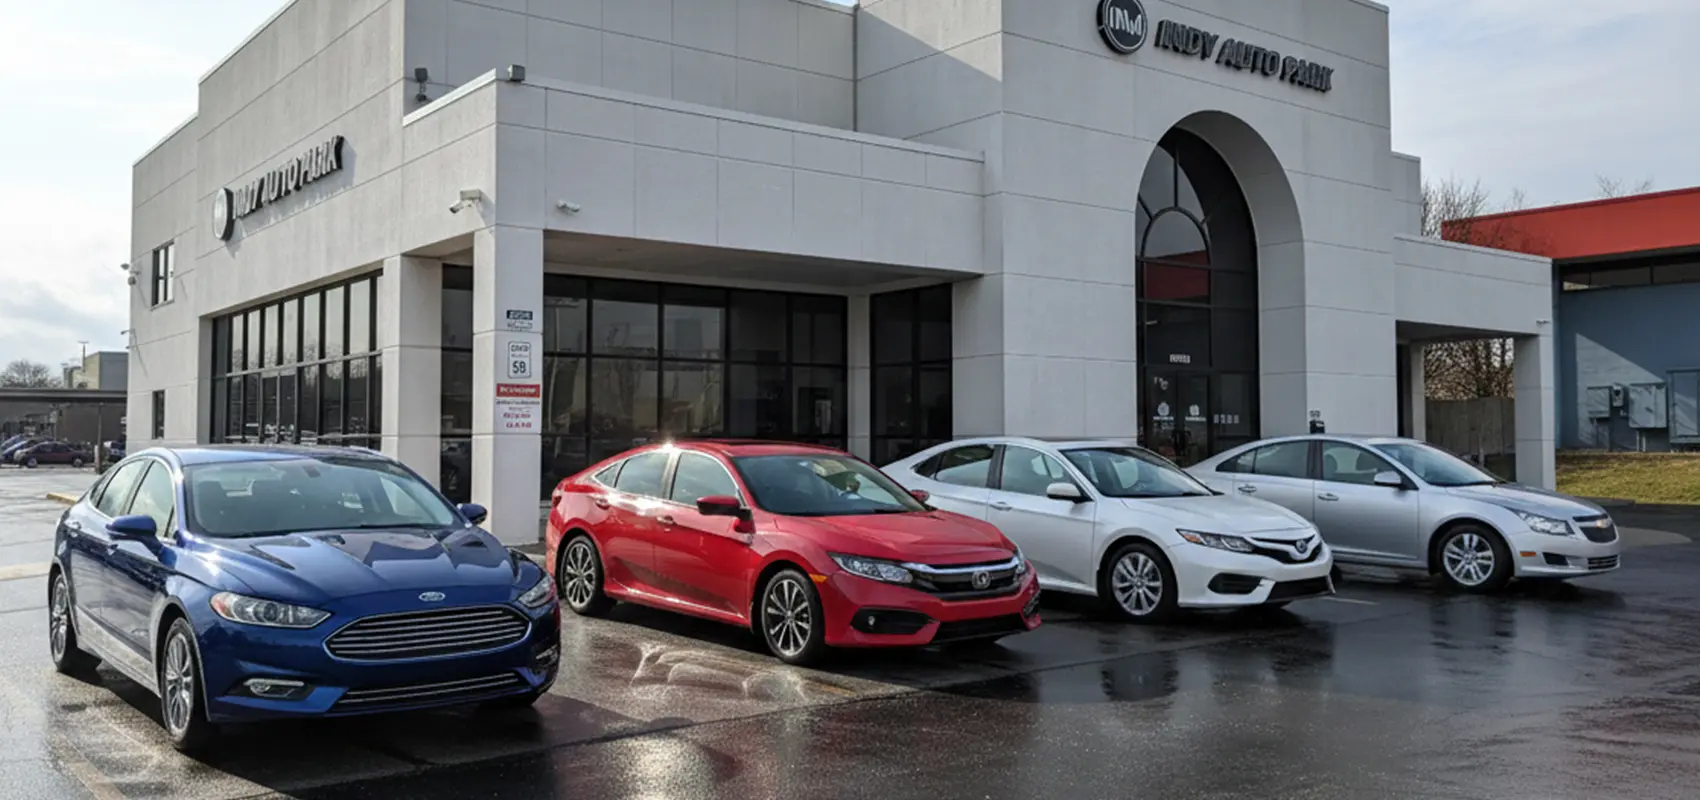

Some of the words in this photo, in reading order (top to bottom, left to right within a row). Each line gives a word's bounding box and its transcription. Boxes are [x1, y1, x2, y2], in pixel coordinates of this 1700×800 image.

[1154, 19, 1219, 61] INDY
[1215, 38, 1280, 77] AUTO
[1279, 56, 1335, 93] PARK
